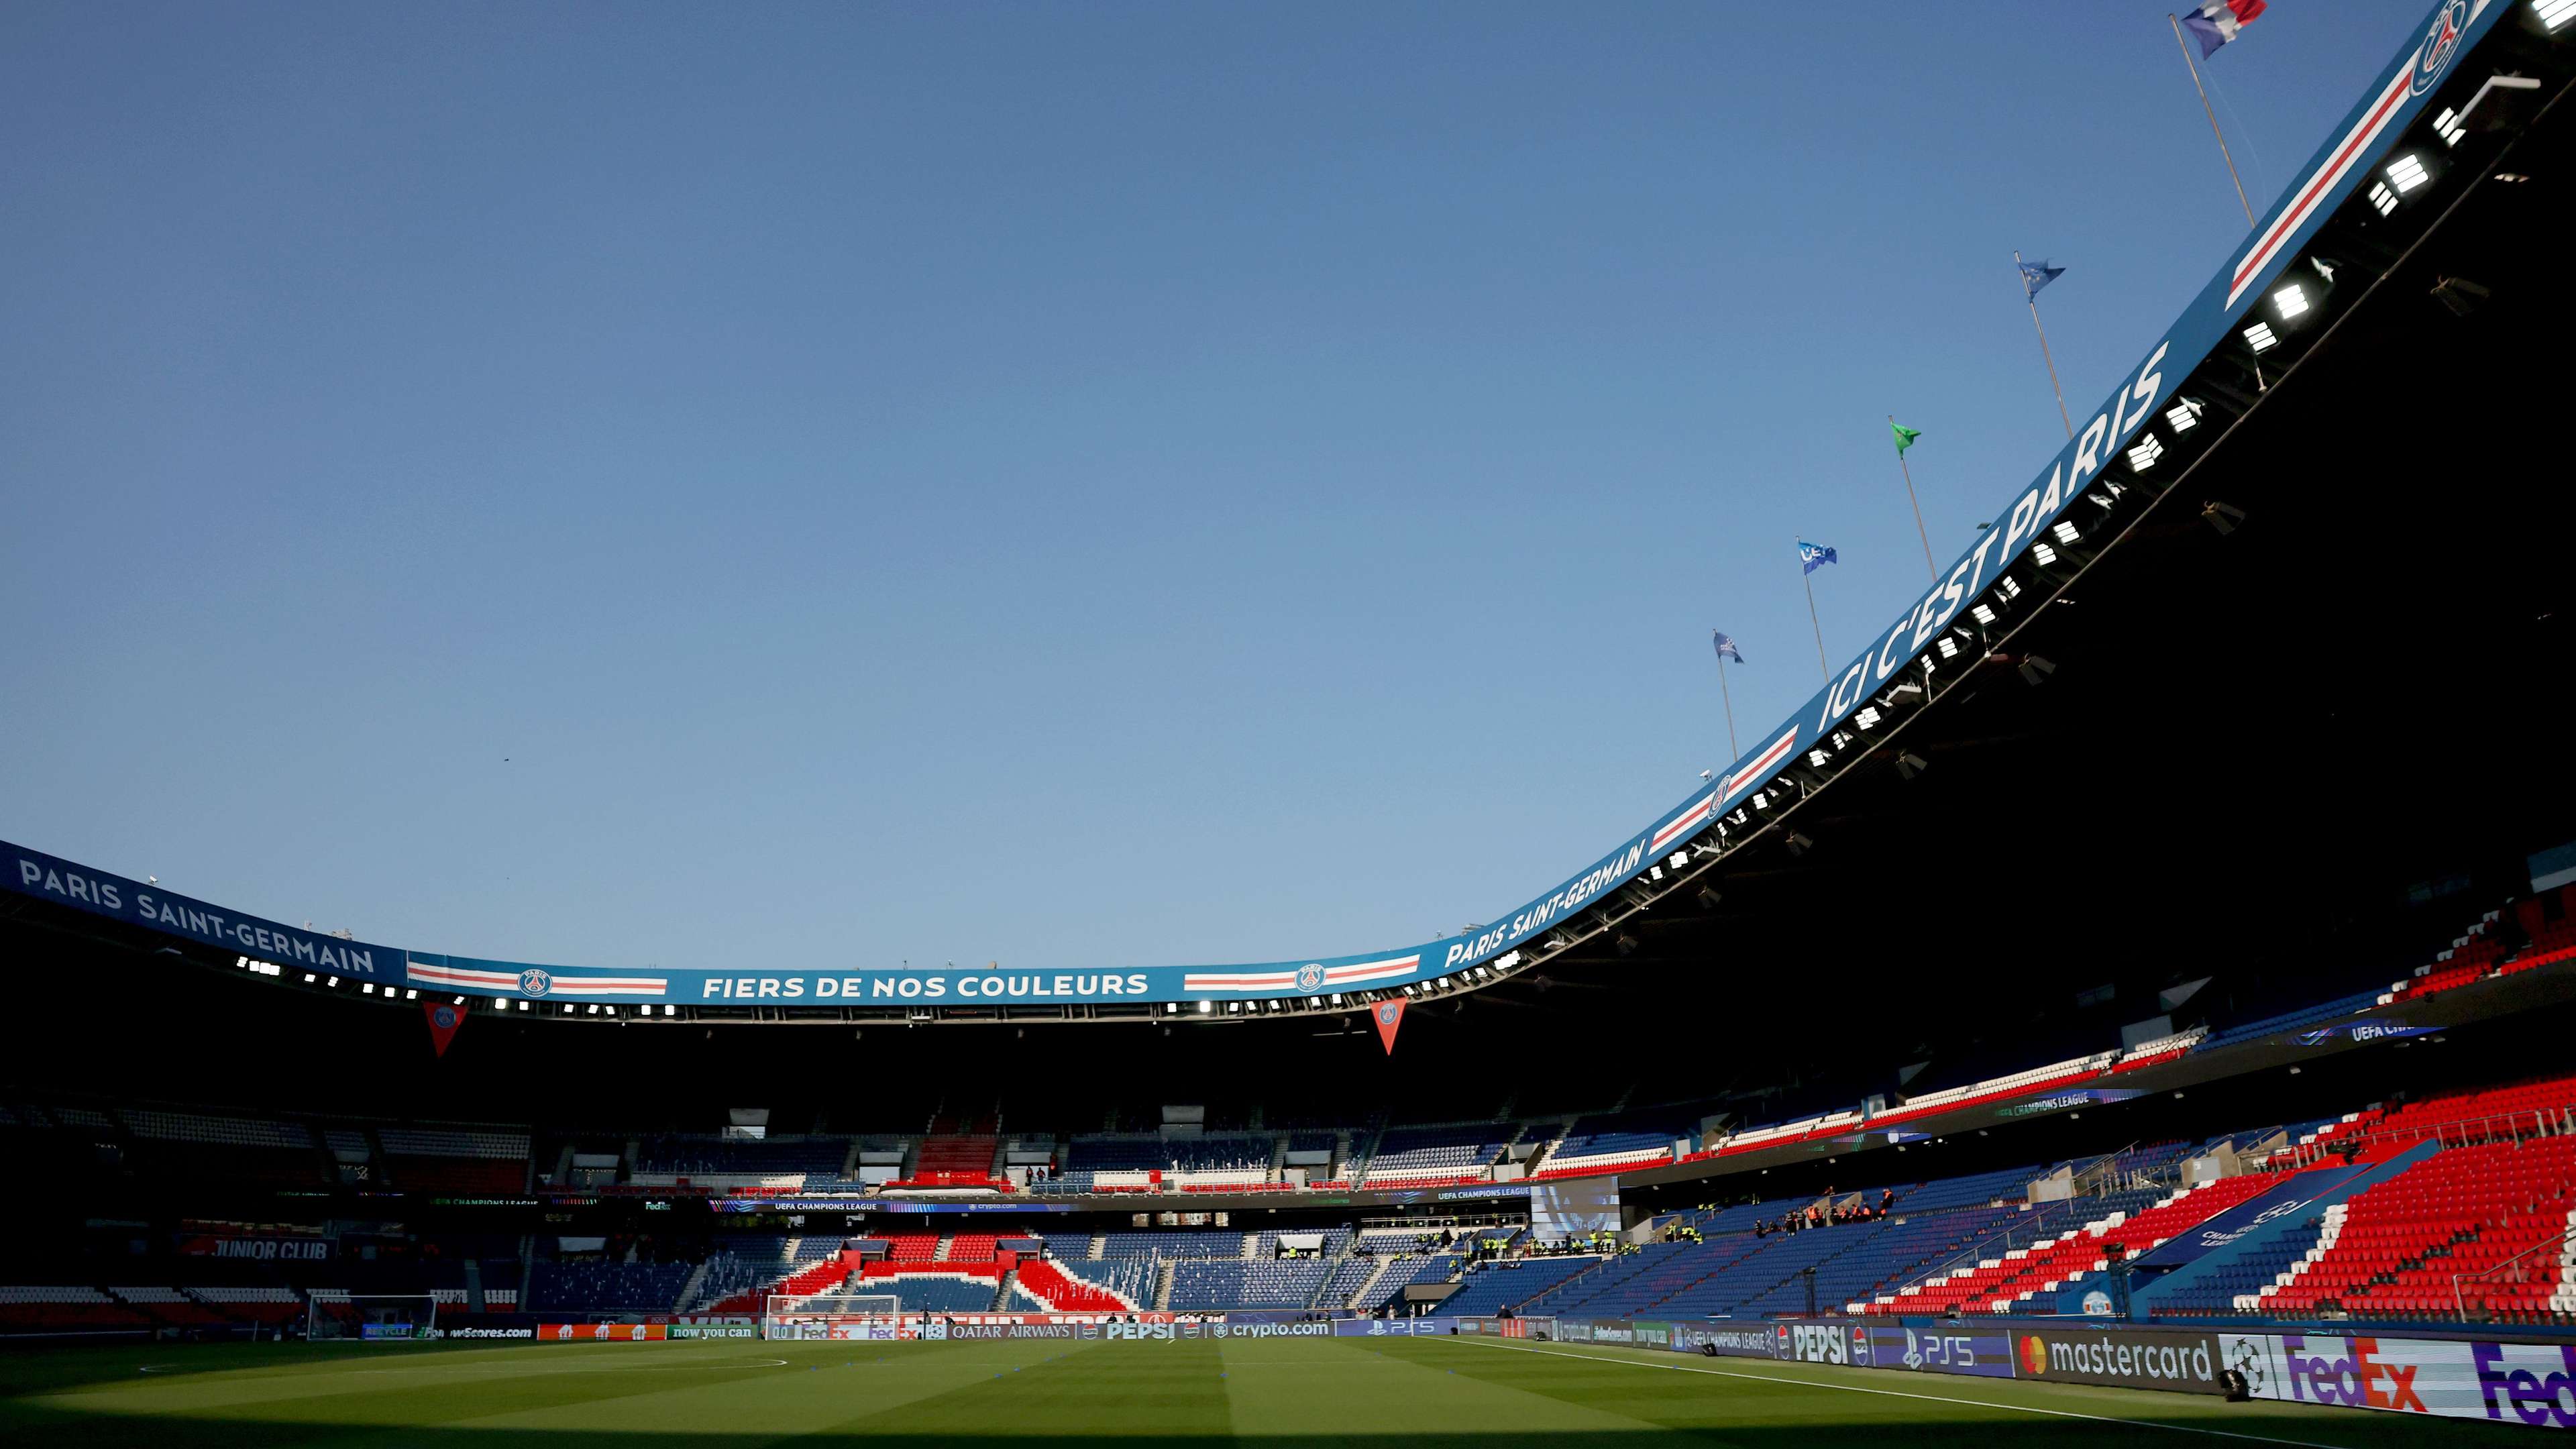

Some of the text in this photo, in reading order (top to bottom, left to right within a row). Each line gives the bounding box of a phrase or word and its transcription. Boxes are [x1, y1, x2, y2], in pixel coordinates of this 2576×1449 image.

[1818, 340, 2169, 733] ICI C'EST PARIS
[1444, 839, 1646, 968] PARIS SAINT-GERMAIN
[19, 859, 374, 973] PARIS SAINT-GERMAIN
[524, 970, 547, 979] PARIS
[703, 974, 1148, 998] FIERS DE NOS COULEURS
[2014, 1100, 2057, 1116] CHAMPIONS
[2057, 1091, 2090, 1108] LEAGUE
[1438, 1186, 1530, 1201] UEFA CHAMPIONS LEAGUE
[775, 1203, 796, 1211] UEFA
[798, 1203, 845, 1211] CHAMPIONS
[214, 1240, 327, 1260] JUNIOR CLUB
[673, 1328, 752, 1340] now you can
[952, 1325, 1071, 1339] QATAR AIRWAYS
[1107, 1323, 1175, 1340] PEPSI
[1232, 1322, 1329, 1338] crypto.com
[1390, 1321, 1435, 1334] PS5
[1691, 1330, 1707, 1346] UEFA
[1706, 1330, 1741, 1349] CHAMPIONS
[1742, 1332, 1766, 1350] LEAGUE
[1792, 1325, 1848, 1364] PEPSI
[1924, 1336, 1974, 1367] PS5
[2051, 1337, 2213, 1382] mastercard
[2282, 1335, 2429, 1413] FedEx
